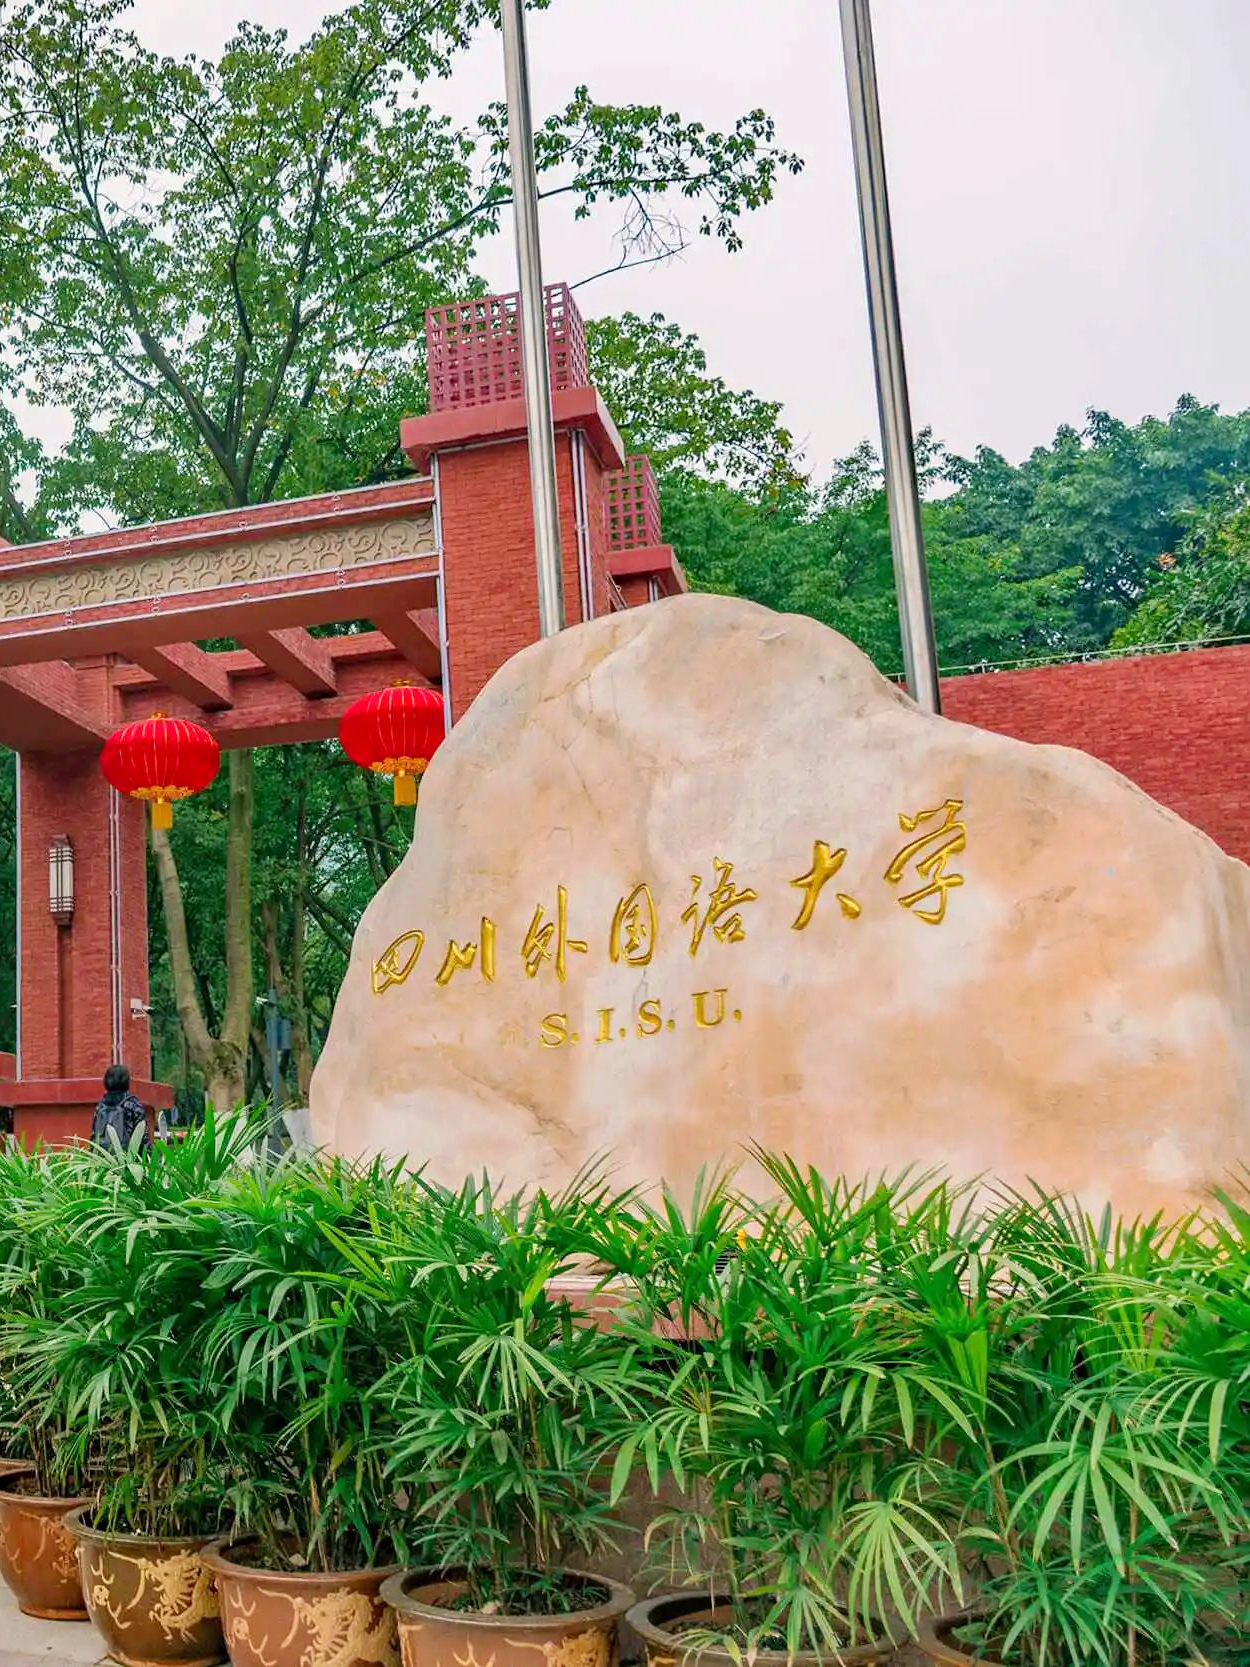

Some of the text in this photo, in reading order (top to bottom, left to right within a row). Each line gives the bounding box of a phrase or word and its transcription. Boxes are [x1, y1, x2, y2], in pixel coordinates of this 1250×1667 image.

[371, 798, 967, 995] 四川外国语大学
